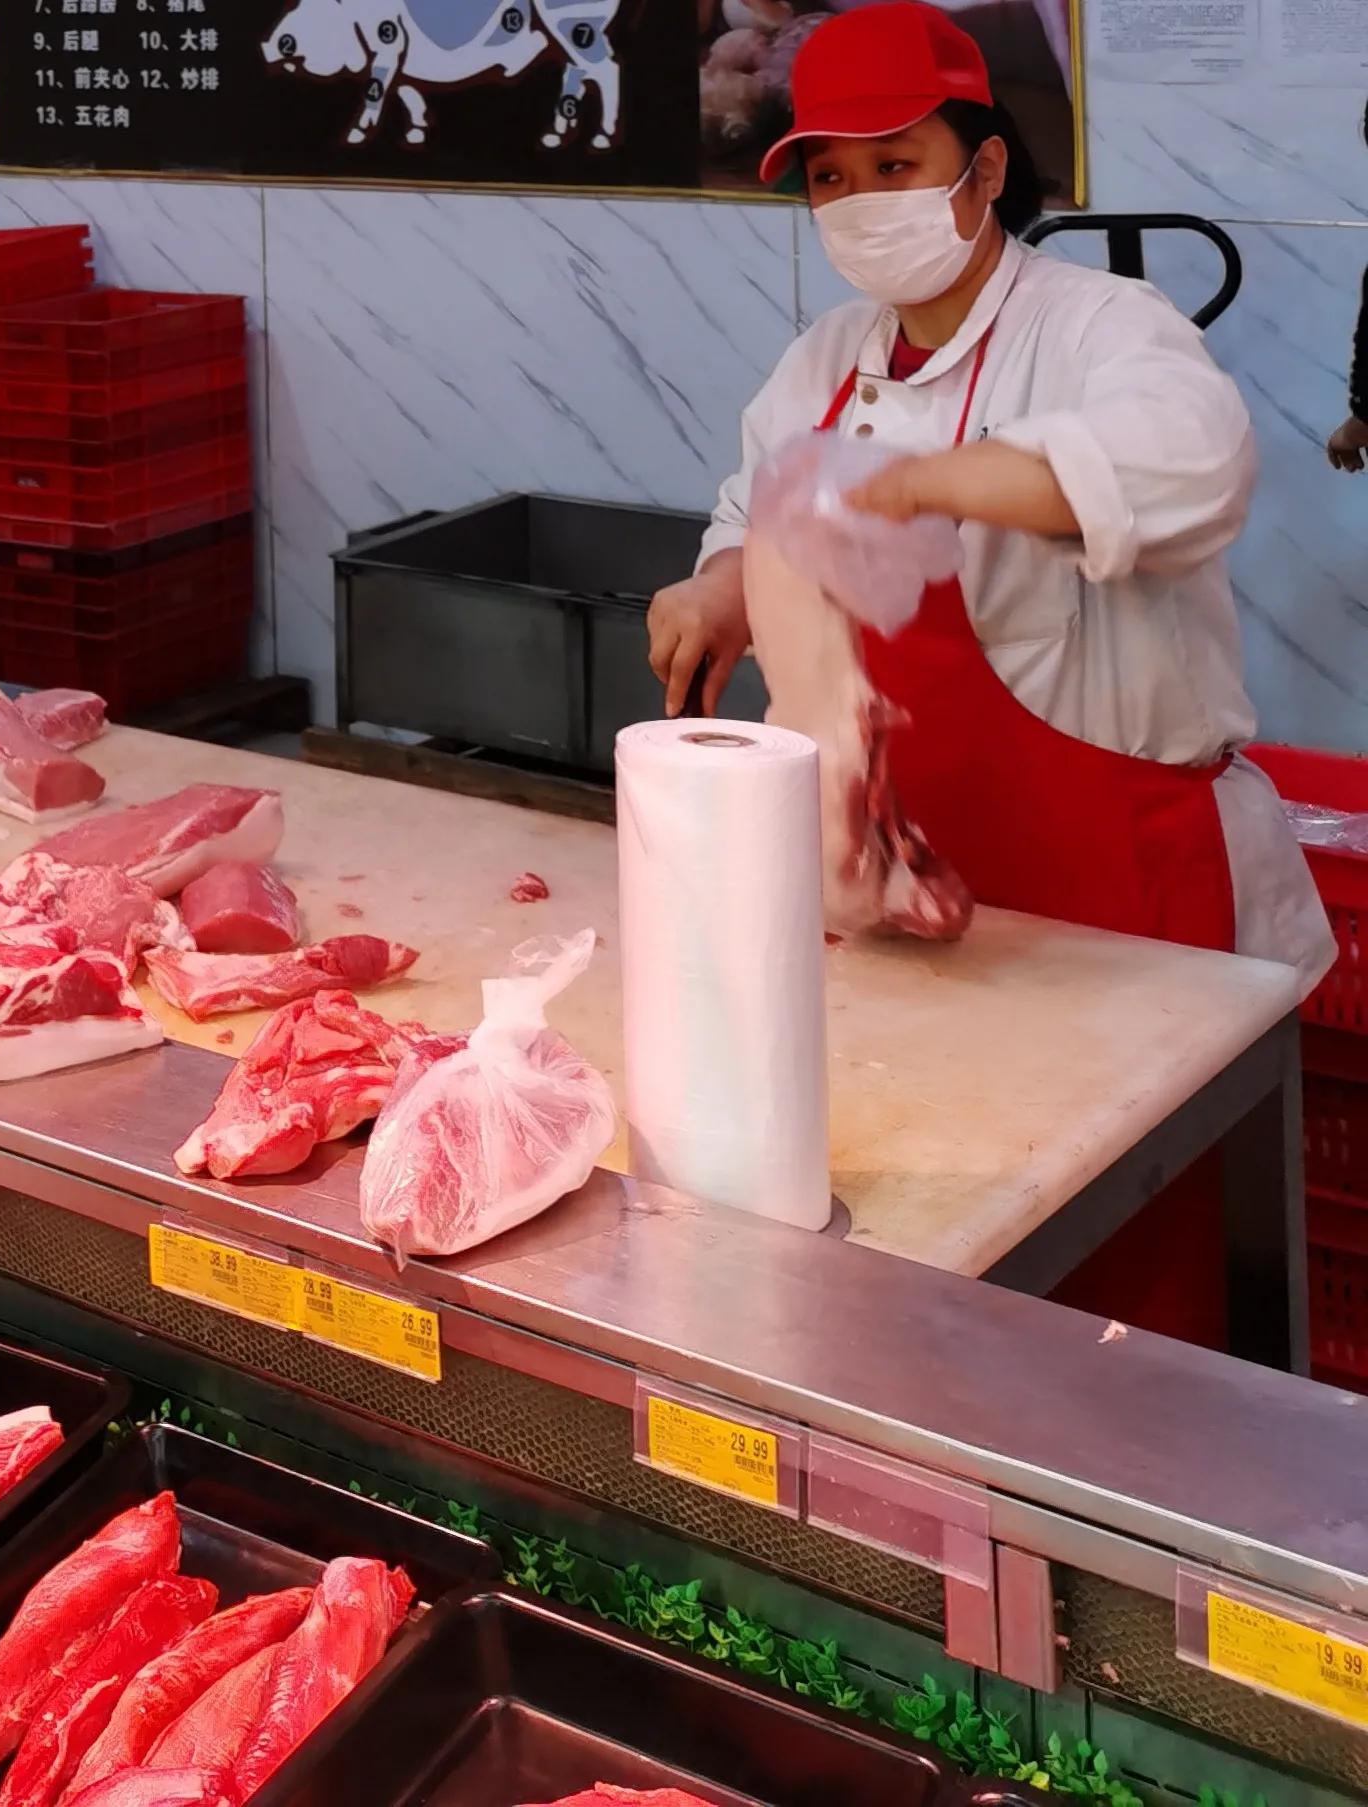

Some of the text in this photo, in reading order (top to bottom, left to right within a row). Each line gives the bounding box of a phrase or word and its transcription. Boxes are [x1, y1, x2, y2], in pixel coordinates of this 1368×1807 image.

[401, 1311, 432, 1337] 26.99
[730, 1431, 768, 1460] 29.99
[1315, 1641, 1363, 1676] 19.99
